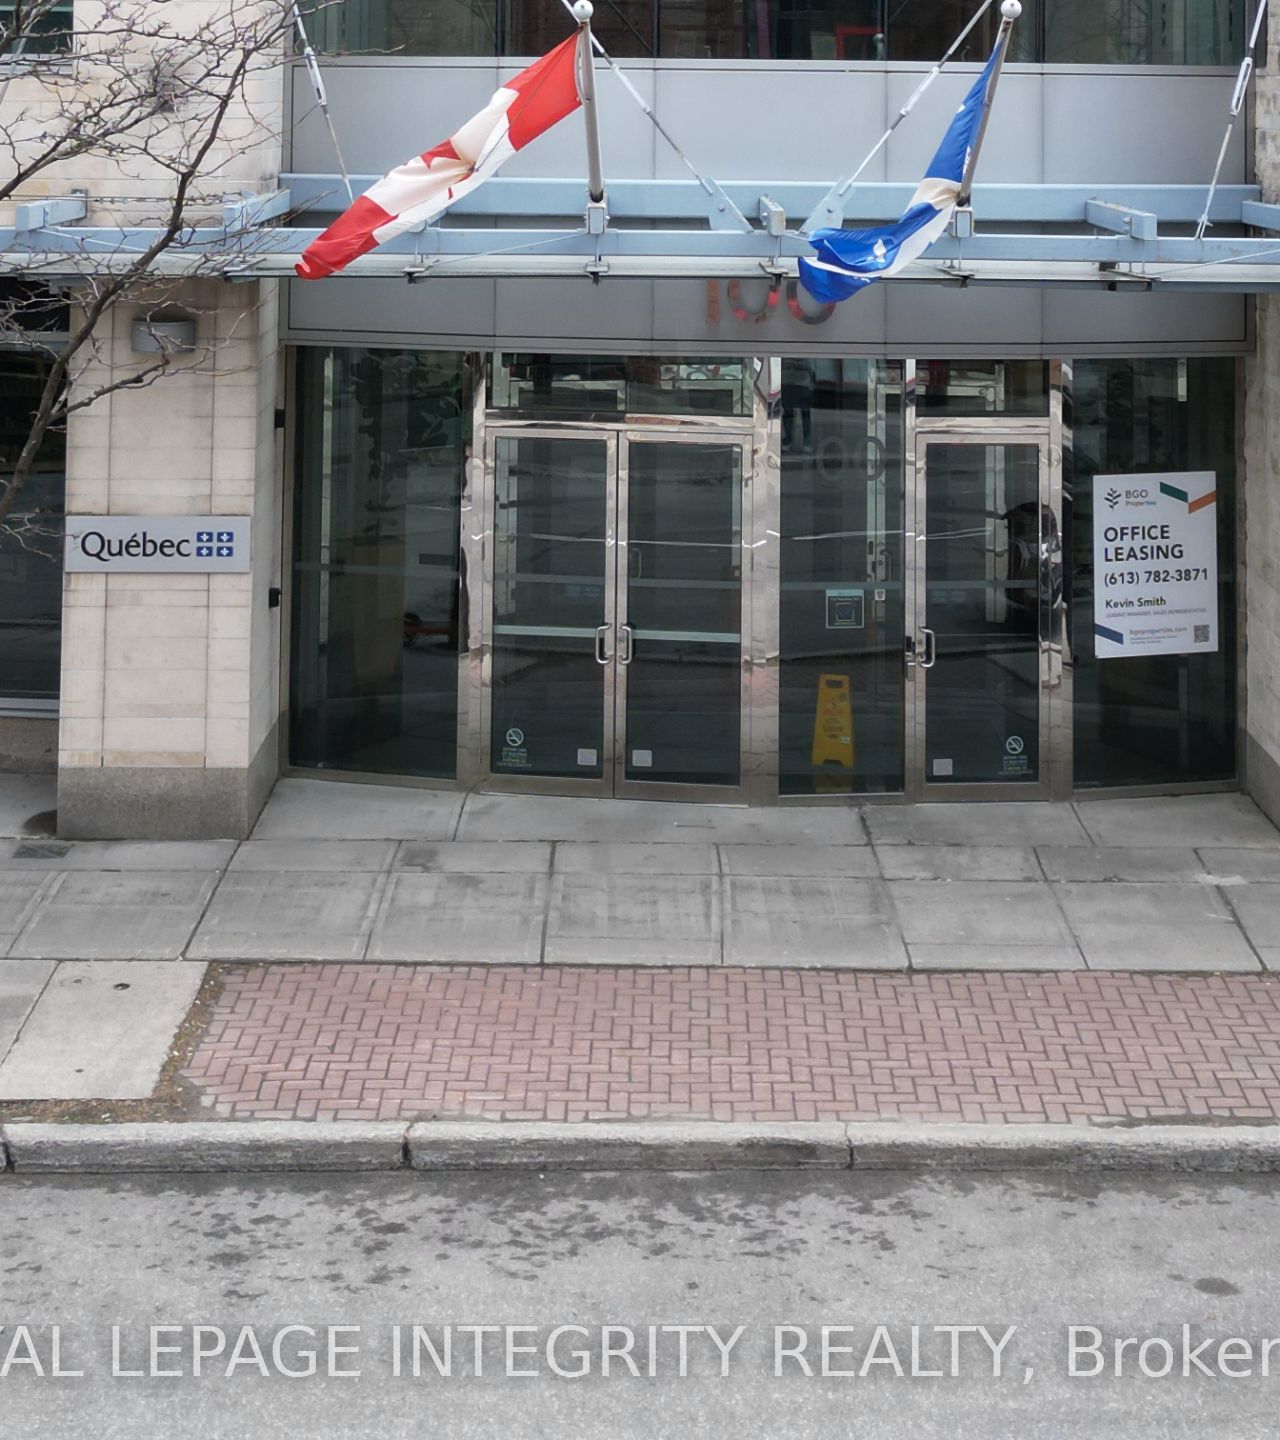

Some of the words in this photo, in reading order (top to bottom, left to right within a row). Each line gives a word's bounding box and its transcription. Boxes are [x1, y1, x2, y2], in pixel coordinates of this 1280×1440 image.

[1125, 489, 1149, 499] BGO
[1104, 525, 1170, 542] OFFICE
[81, 531, 191, 562] Québec
[1104, 544, 1184, 562] LEASING
[1104, 571, 1140, 588] (613)
[1144, 568, 1208, 583] 782-3871
[1105, 599, 1134, 609] Kevin
[1137, 596, 1166, 607] Smith
